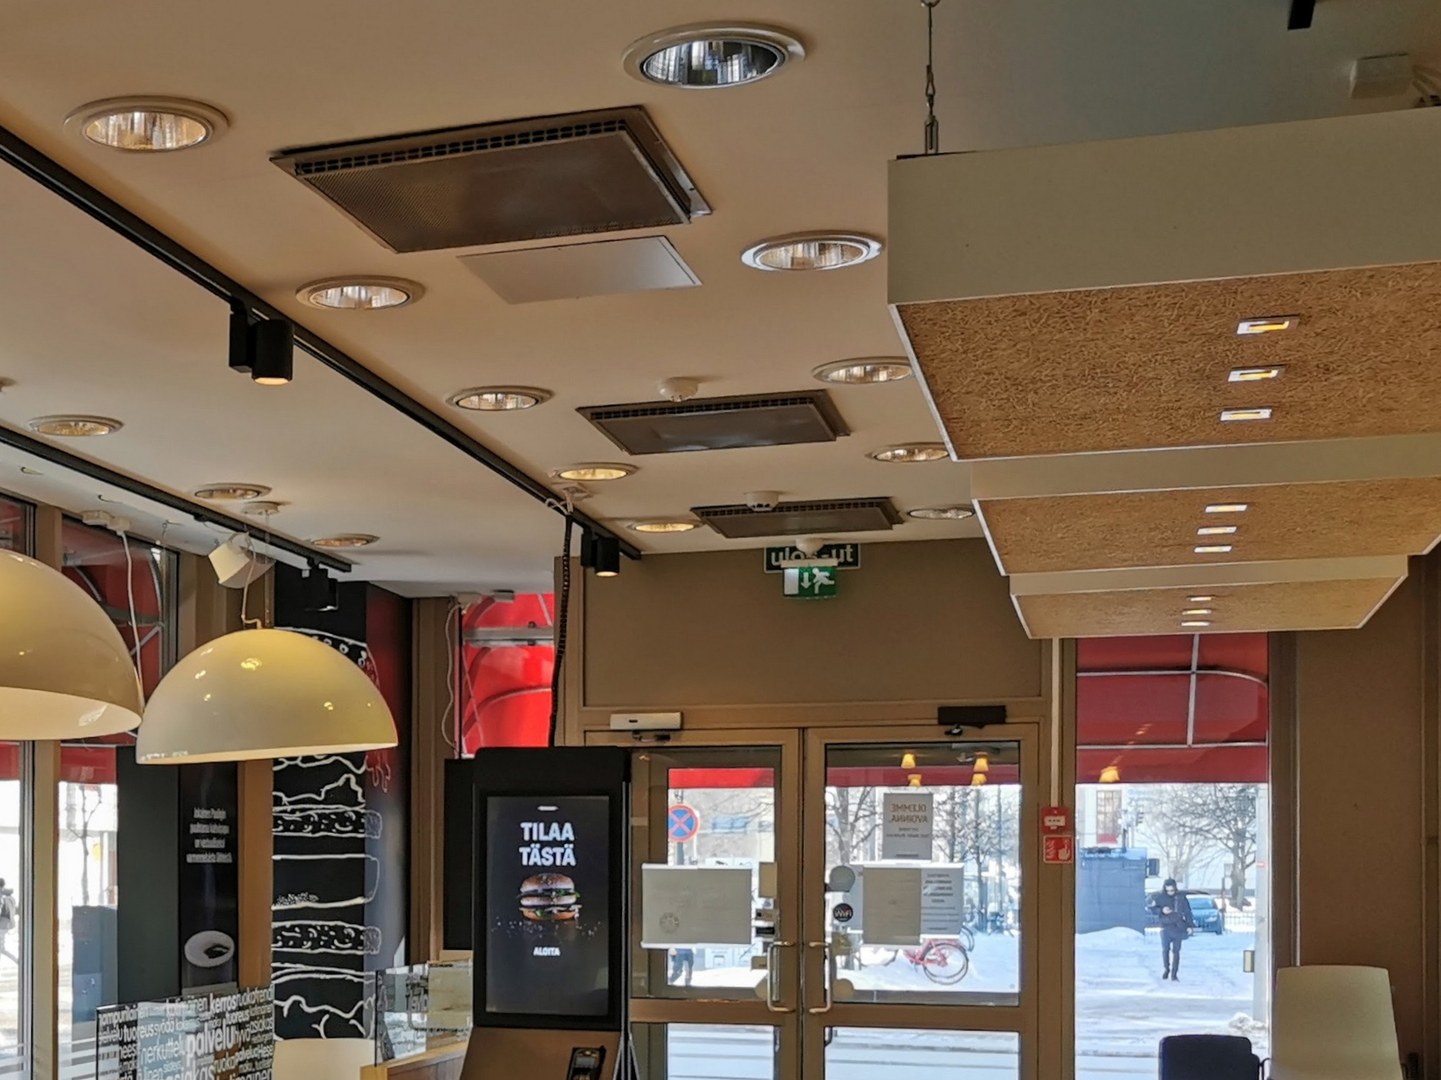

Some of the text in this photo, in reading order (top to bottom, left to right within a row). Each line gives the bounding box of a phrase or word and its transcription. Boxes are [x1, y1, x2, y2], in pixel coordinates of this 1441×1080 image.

[771, 544, 853, 565] ulo-ut
[519, 821, 575, 842] TILAA
[518, 843, 577, 867] TÄSTÄ
[532, 946, 561, 957] ALOITA
[185, 1021, 234, 1066] palvelu
